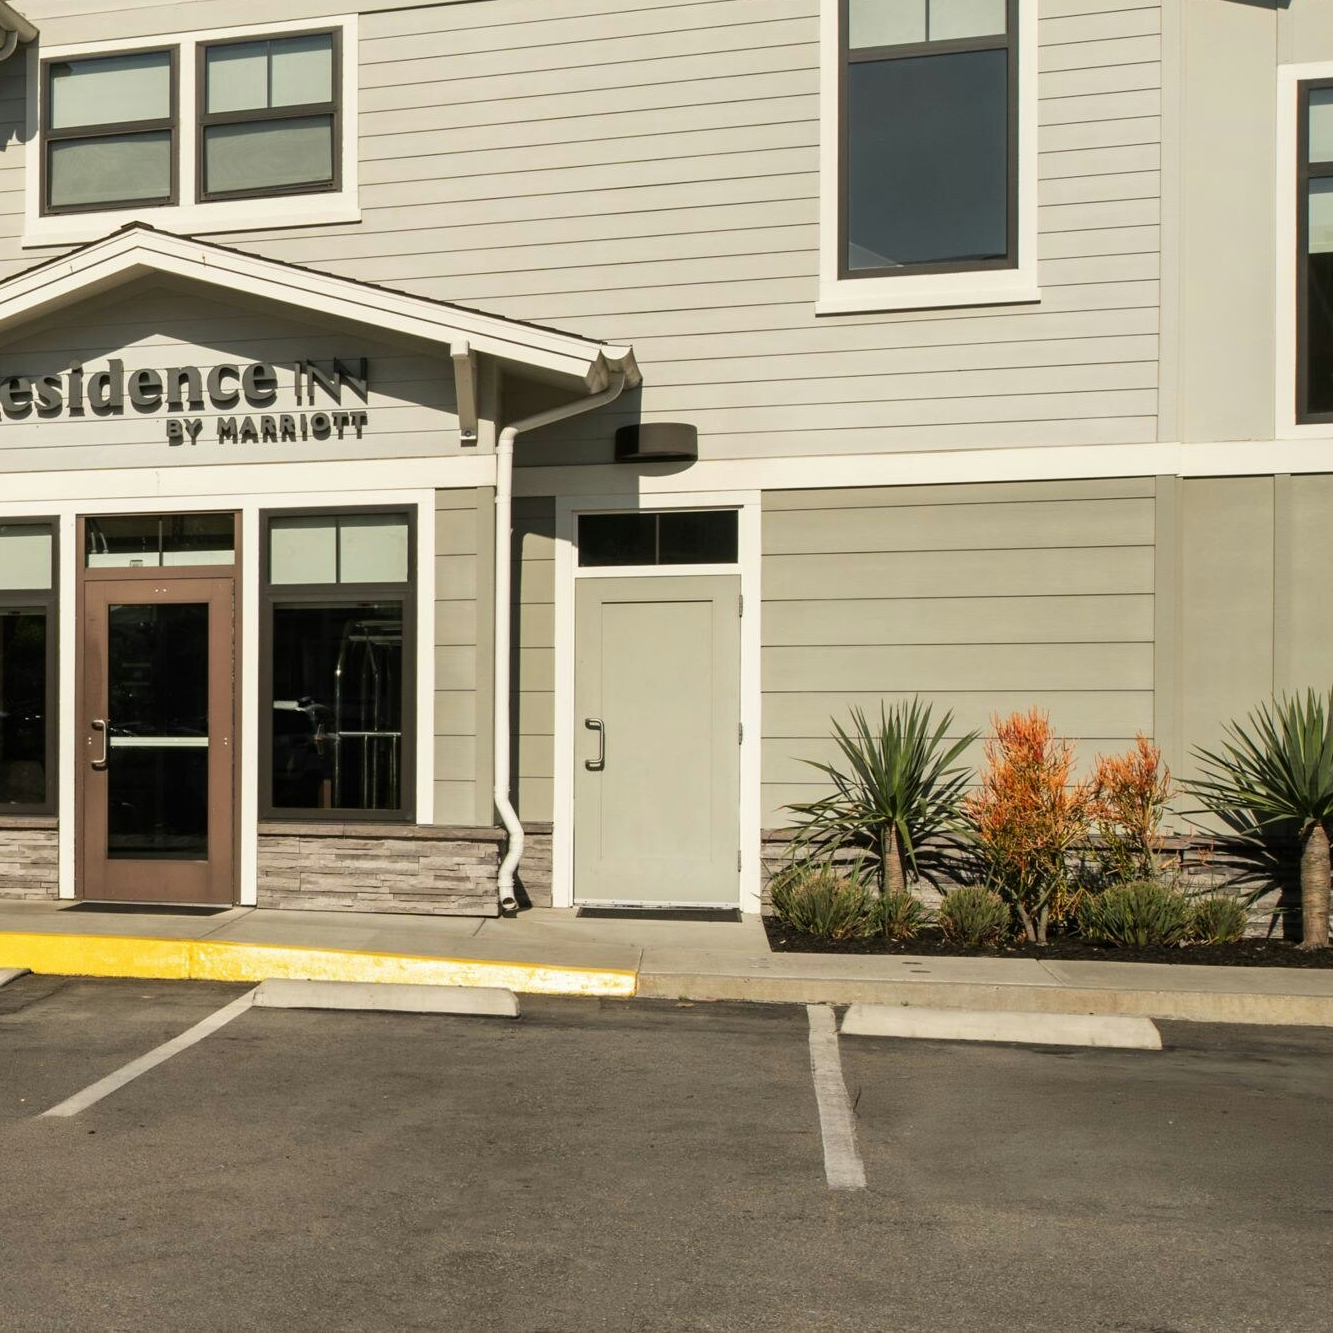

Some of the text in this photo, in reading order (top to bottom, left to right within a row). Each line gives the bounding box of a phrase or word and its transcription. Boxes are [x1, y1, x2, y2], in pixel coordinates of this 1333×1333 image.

[294, 357, 368, 402] INN
[166, 412, 368, 441] BY MARRIOTT
